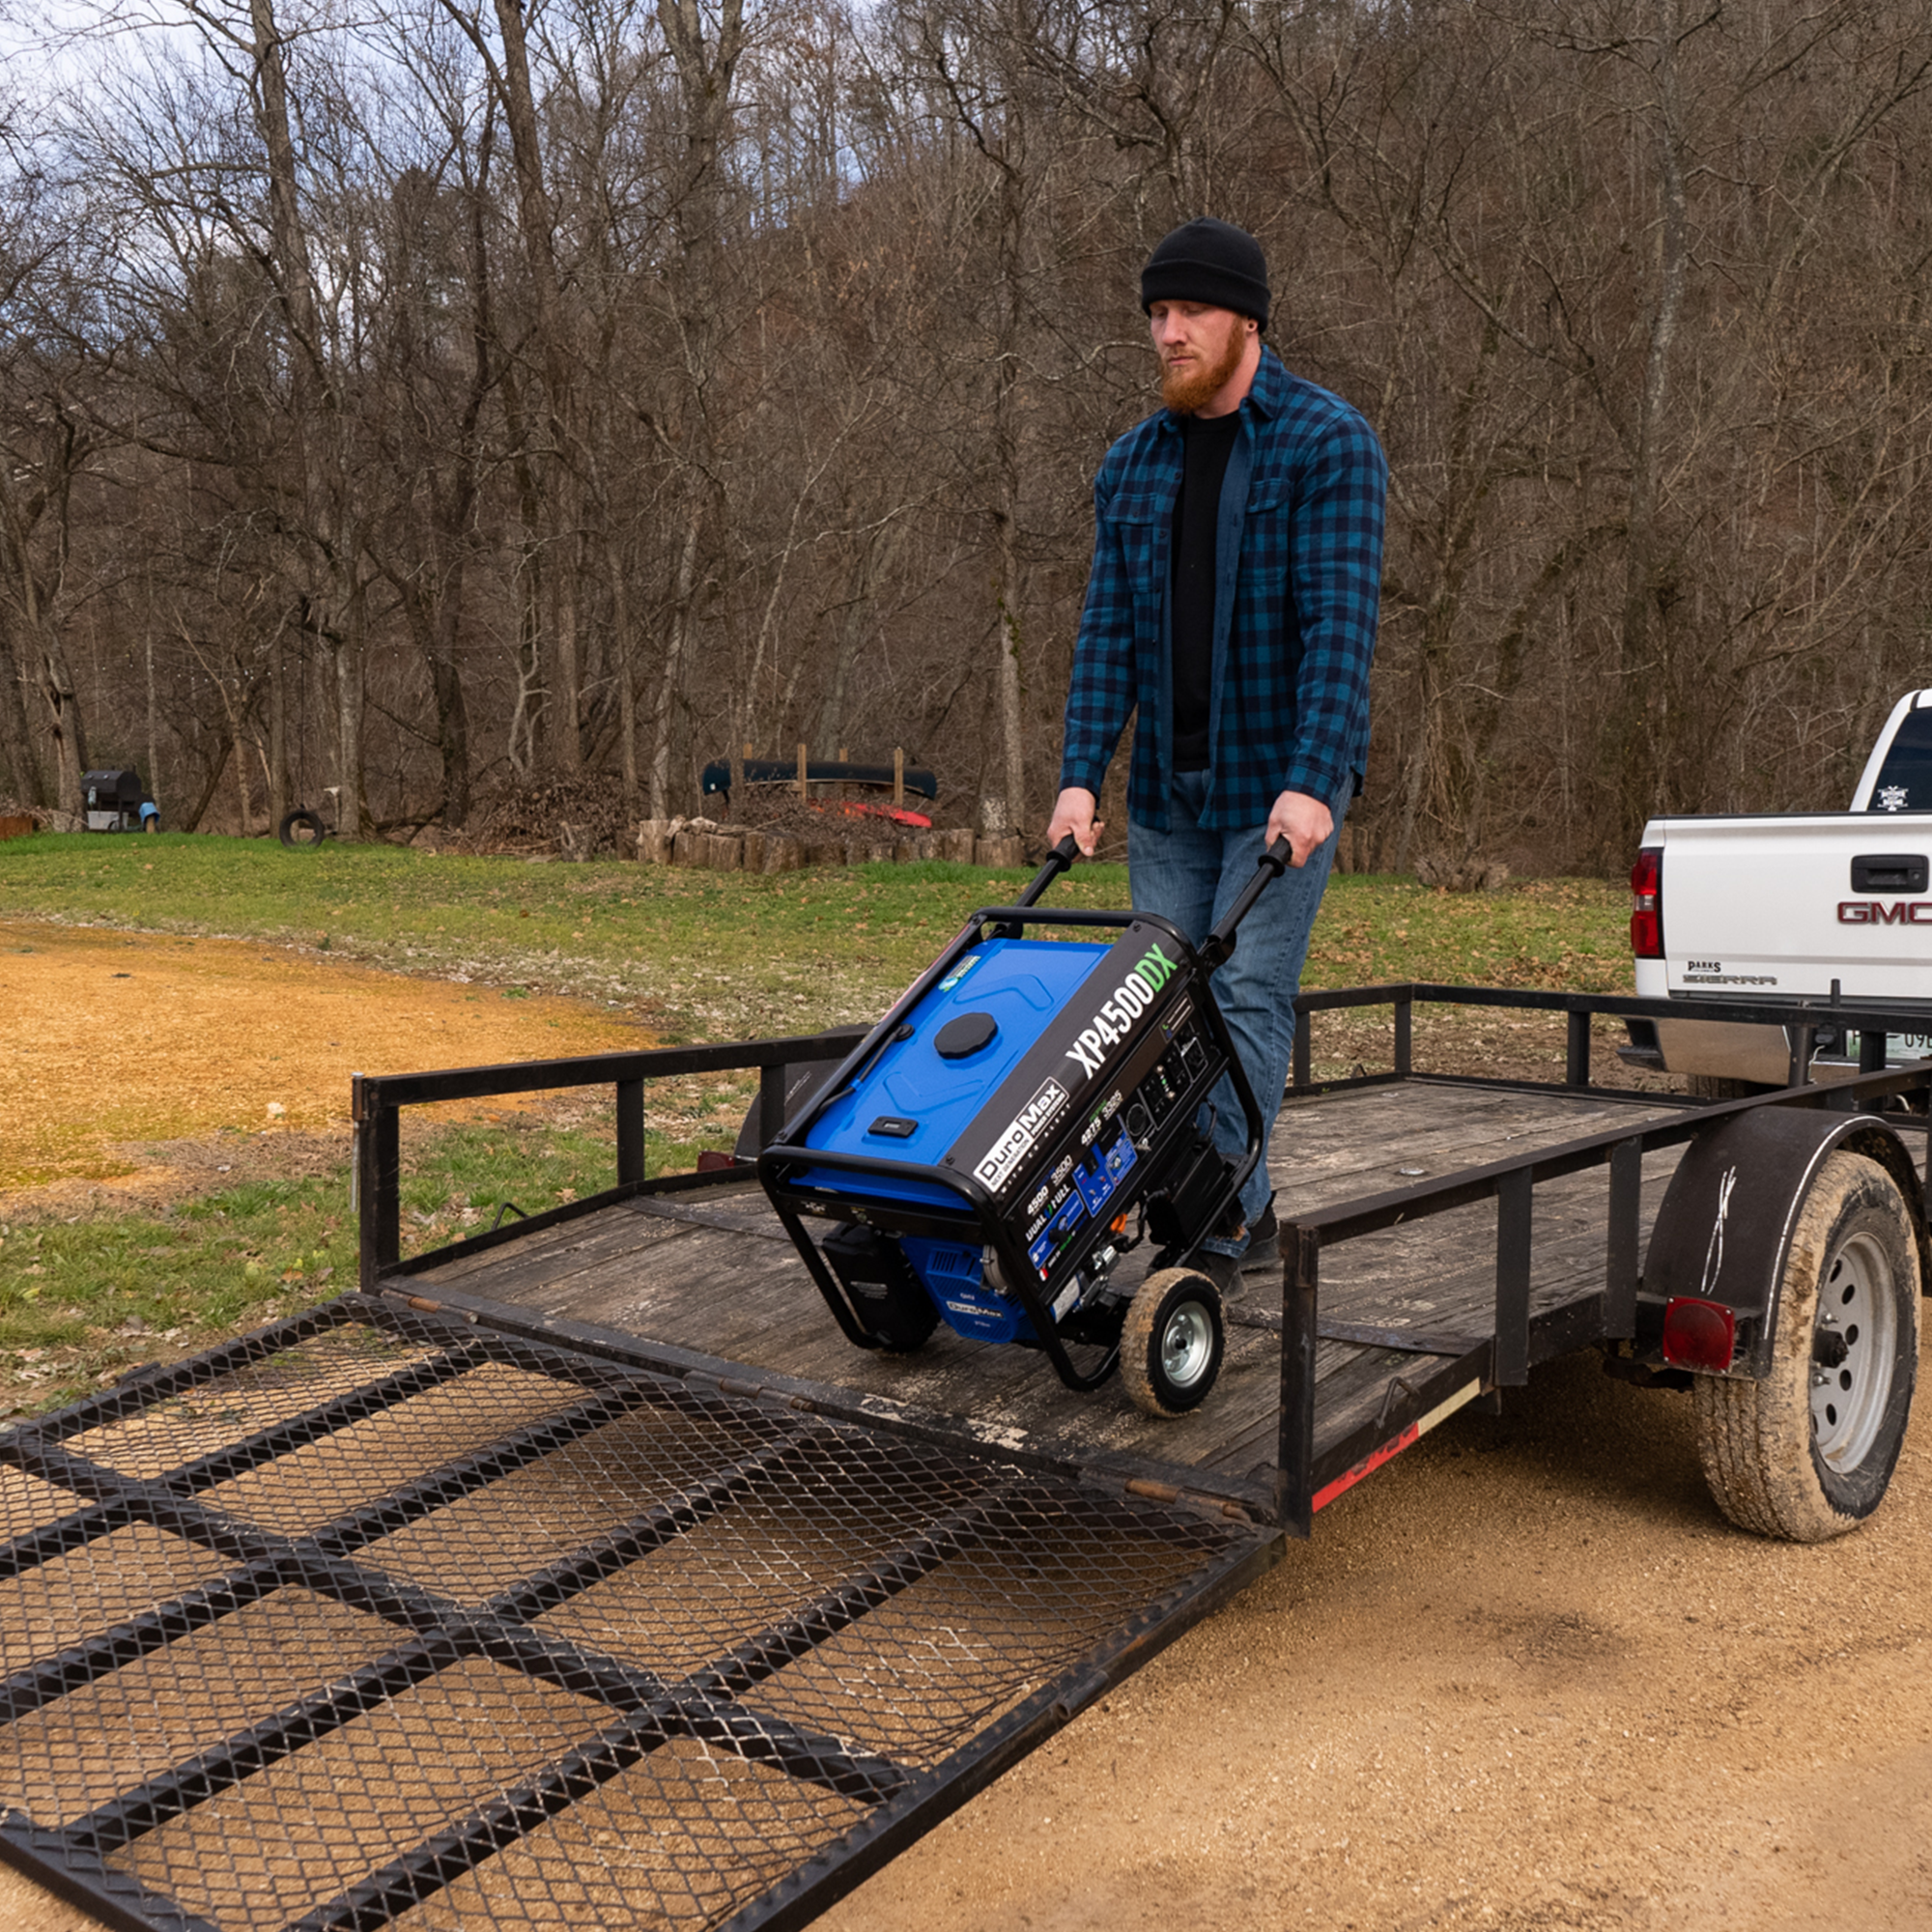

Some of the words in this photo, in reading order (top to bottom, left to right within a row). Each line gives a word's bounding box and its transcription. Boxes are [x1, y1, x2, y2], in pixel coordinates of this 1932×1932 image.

[1837, 901, 1932, 924] GMC
[1688, 960, 1721, 973] PARKS
[1683, 975, 1777, 985] SIERRA
[1065, 943, 1178, 1080] XP4500DX
[1027, 1185, 1049, 1215] 4500
[1050, 1154, 1073, 1184] 3500
